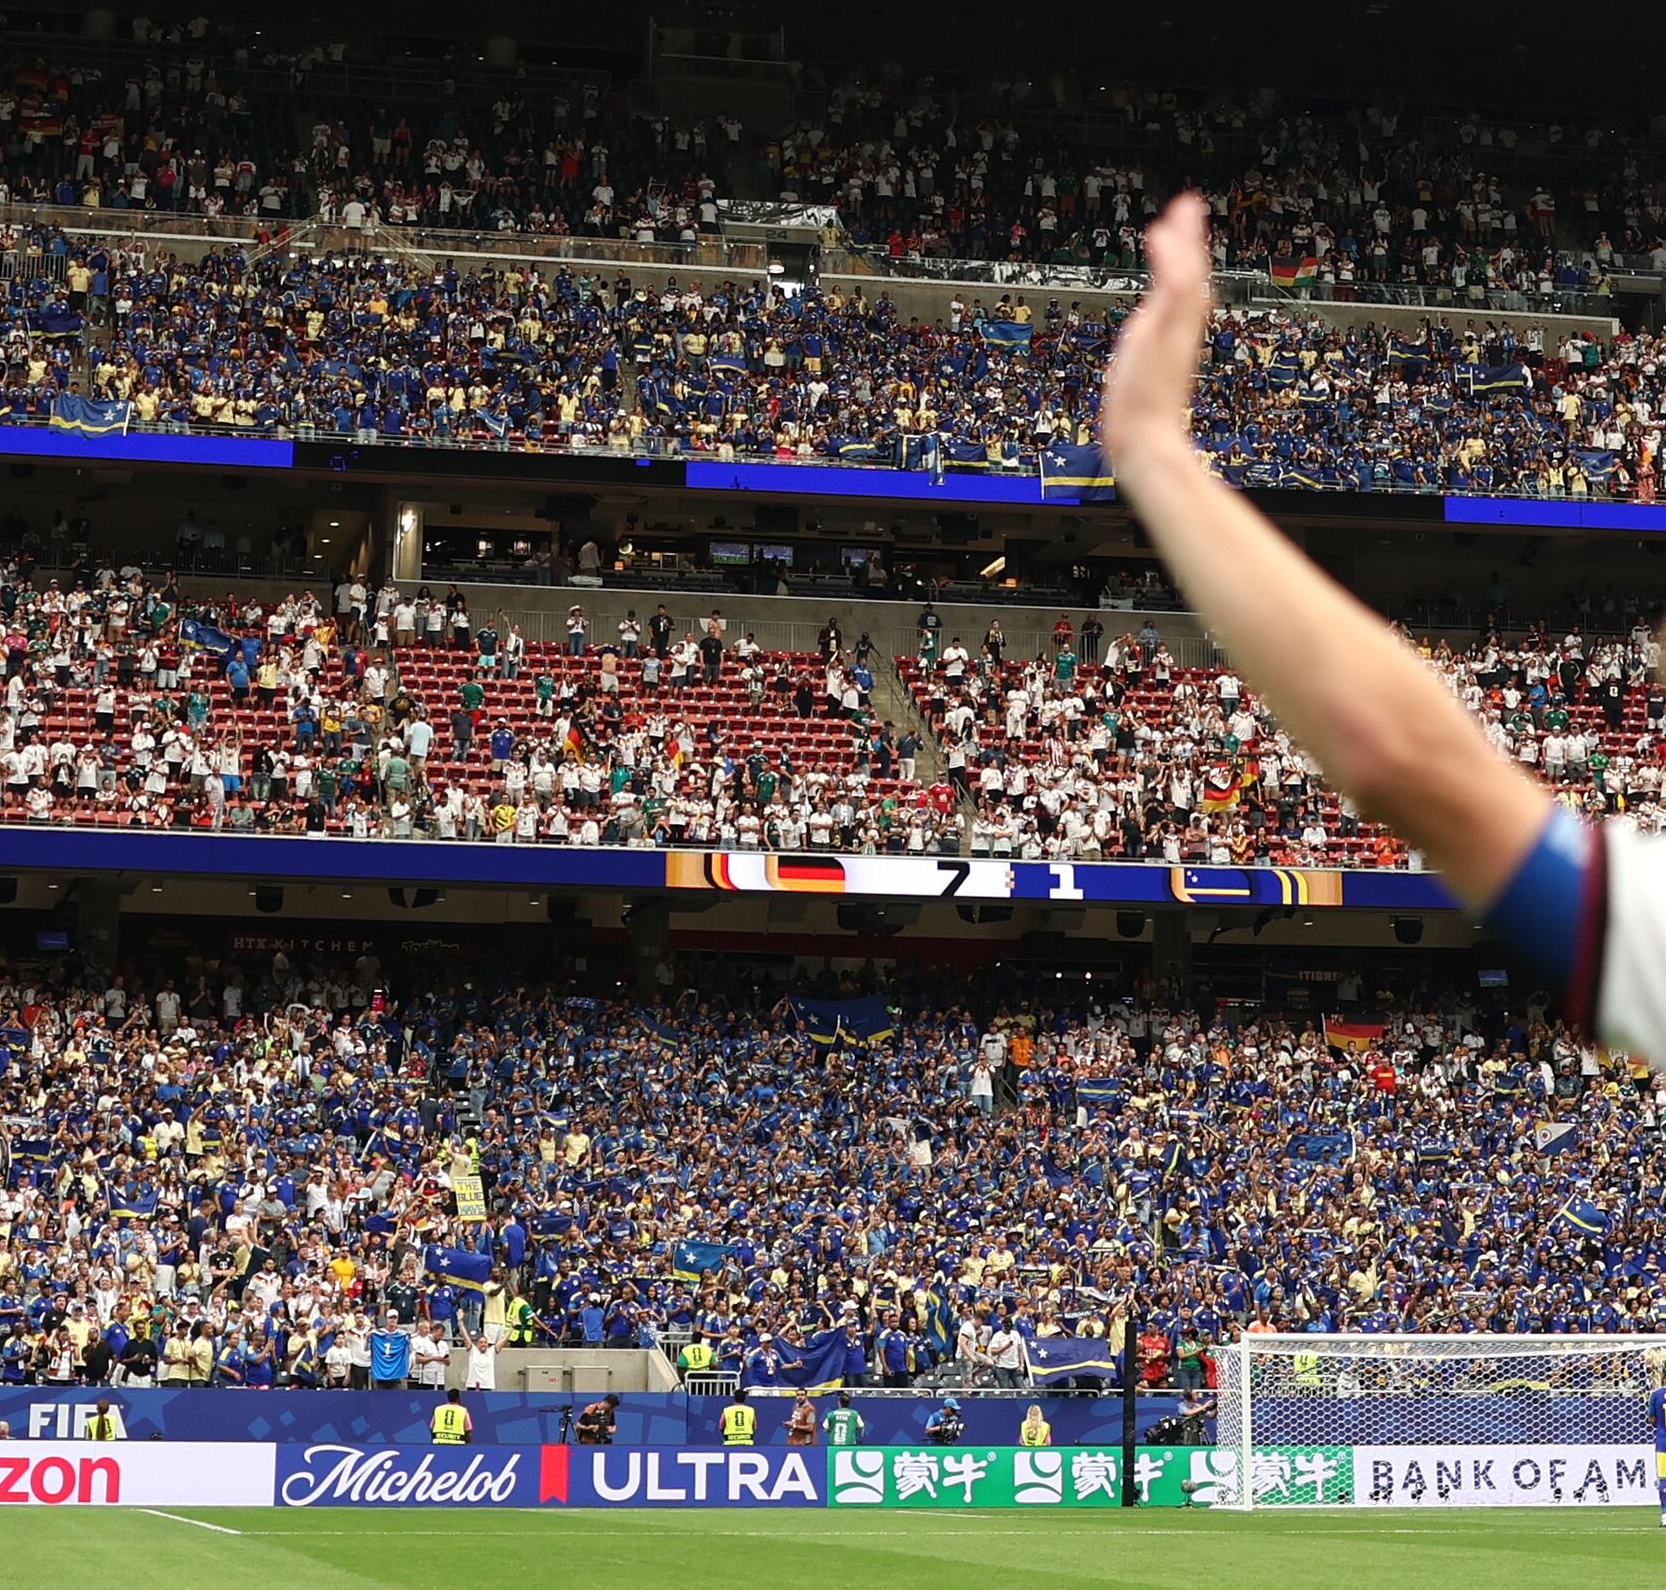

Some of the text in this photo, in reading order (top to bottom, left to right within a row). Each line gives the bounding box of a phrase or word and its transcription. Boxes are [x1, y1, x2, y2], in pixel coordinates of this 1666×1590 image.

[764, 228, 788, 240] 24
[937, 860, 970, 897] 7
[1049, 863, 1084, 900] 1
[233, 937, 268, 950] HTX
[281, 1444, 522, 1508] Michelob
[592, 1452, 819, 1502] ULTRA
[893, 1451, 989, 1502] 蒙牛
[1250, 1452, 1336, 1501] 蒙牛
[1372, 1458, 1495, 1491] BANK
[1512, 1459, 1567, 1490] OF
